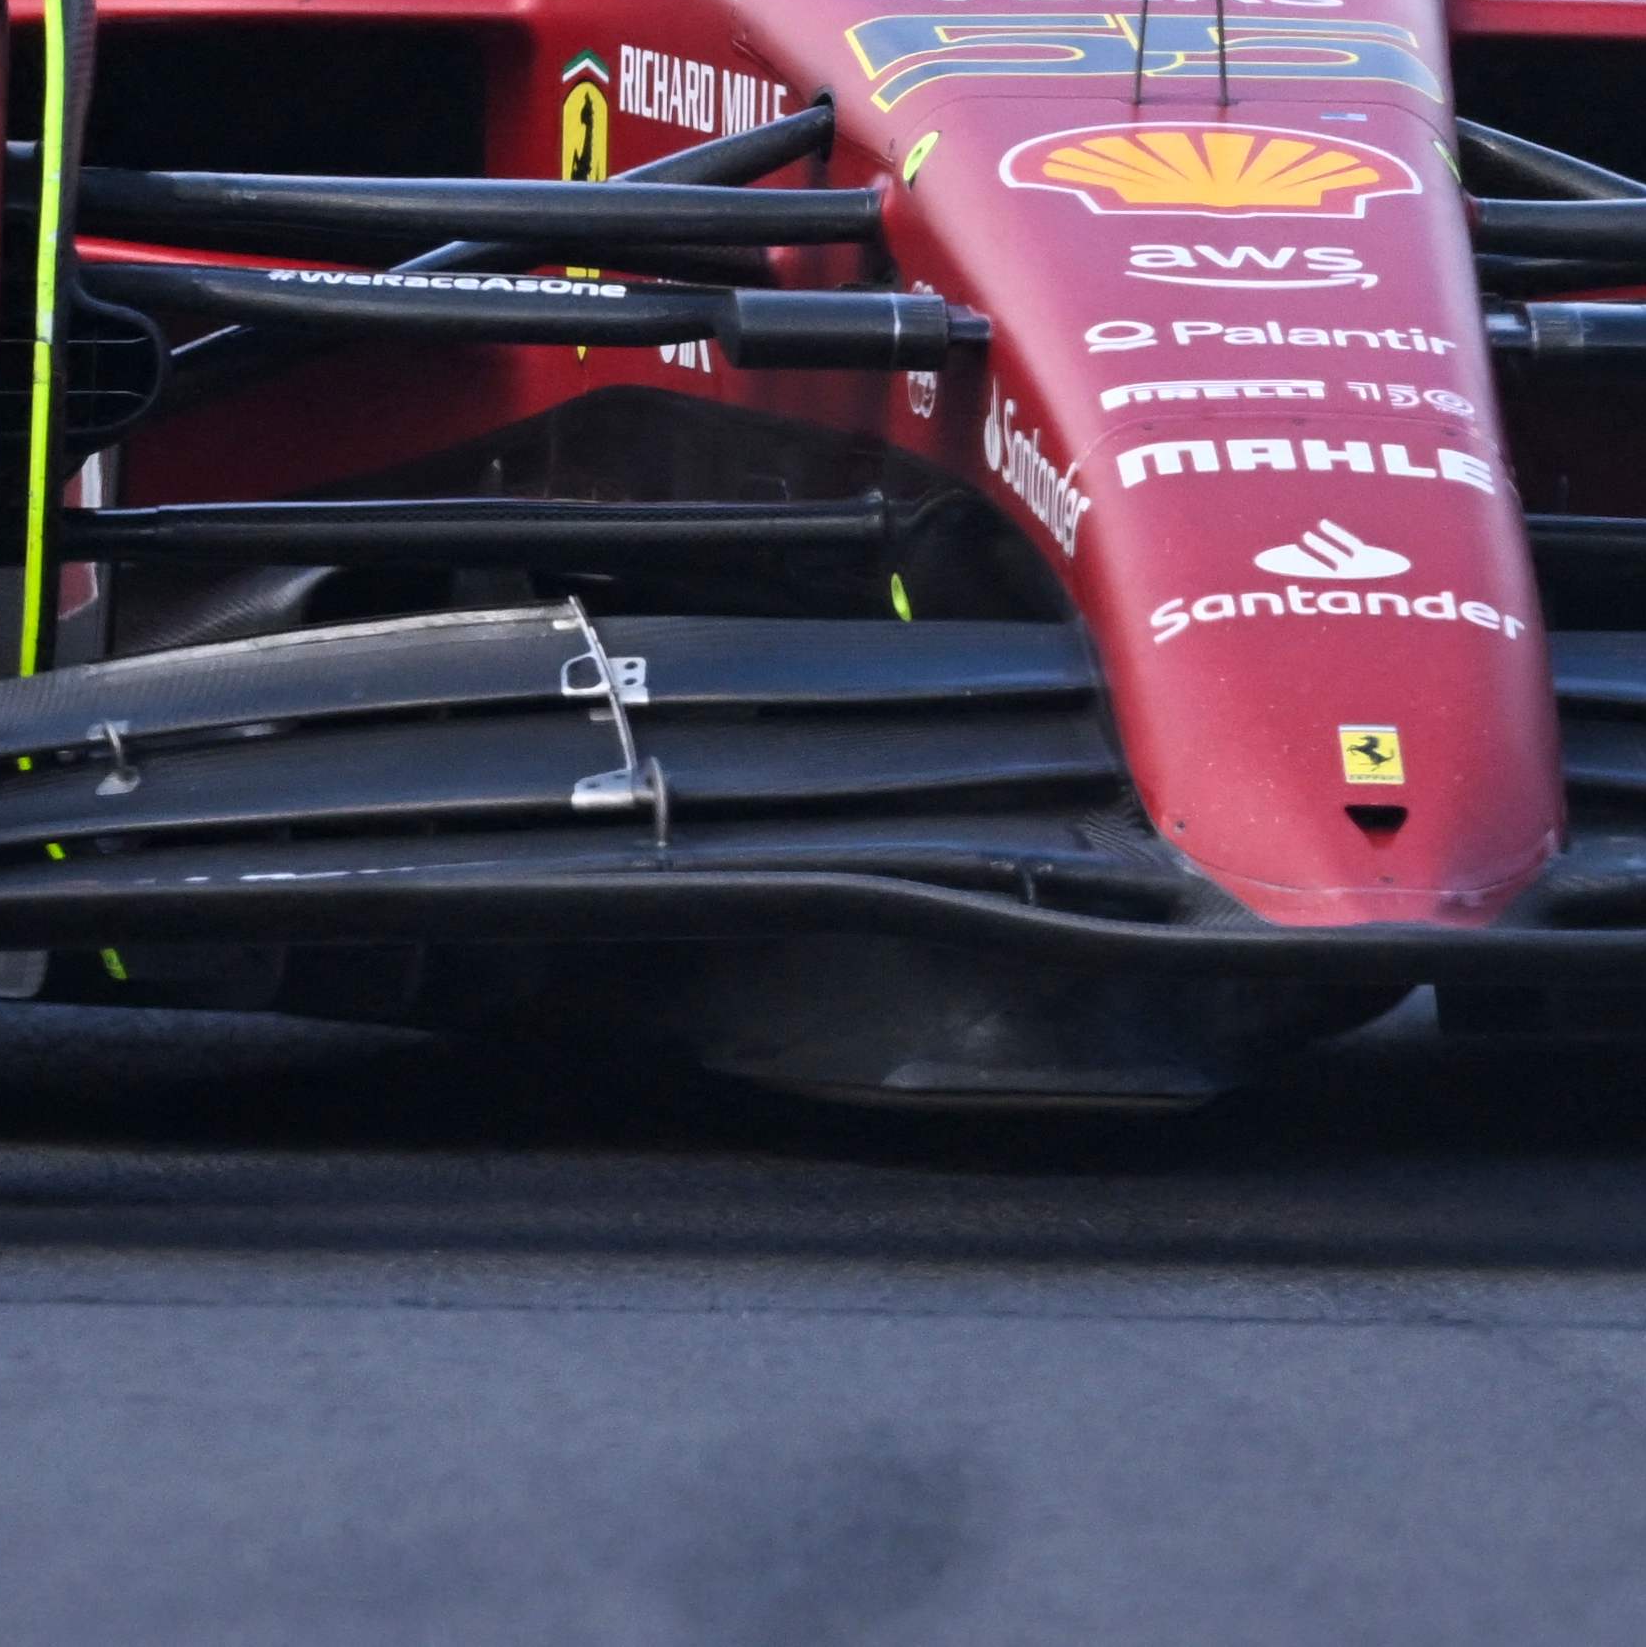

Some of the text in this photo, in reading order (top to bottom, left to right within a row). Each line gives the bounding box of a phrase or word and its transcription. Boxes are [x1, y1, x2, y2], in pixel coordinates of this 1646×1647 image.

[619, 43, 788, 138] RICHARD MILLE
[844, 13, 1445, 112] 55
[267, 269, 628, 298] #WeRaceAsOne
[1129, 242, 1363, 272] aws
[1173, 319, 1457, 356] Palantir
[1100, 379, 1326, 411] PIRELLI
[1002, 398, 1092, 559] Santander
[1116, 438, 1496, 494] MAHLE
[1149, 584, 1526, 644] Santander
